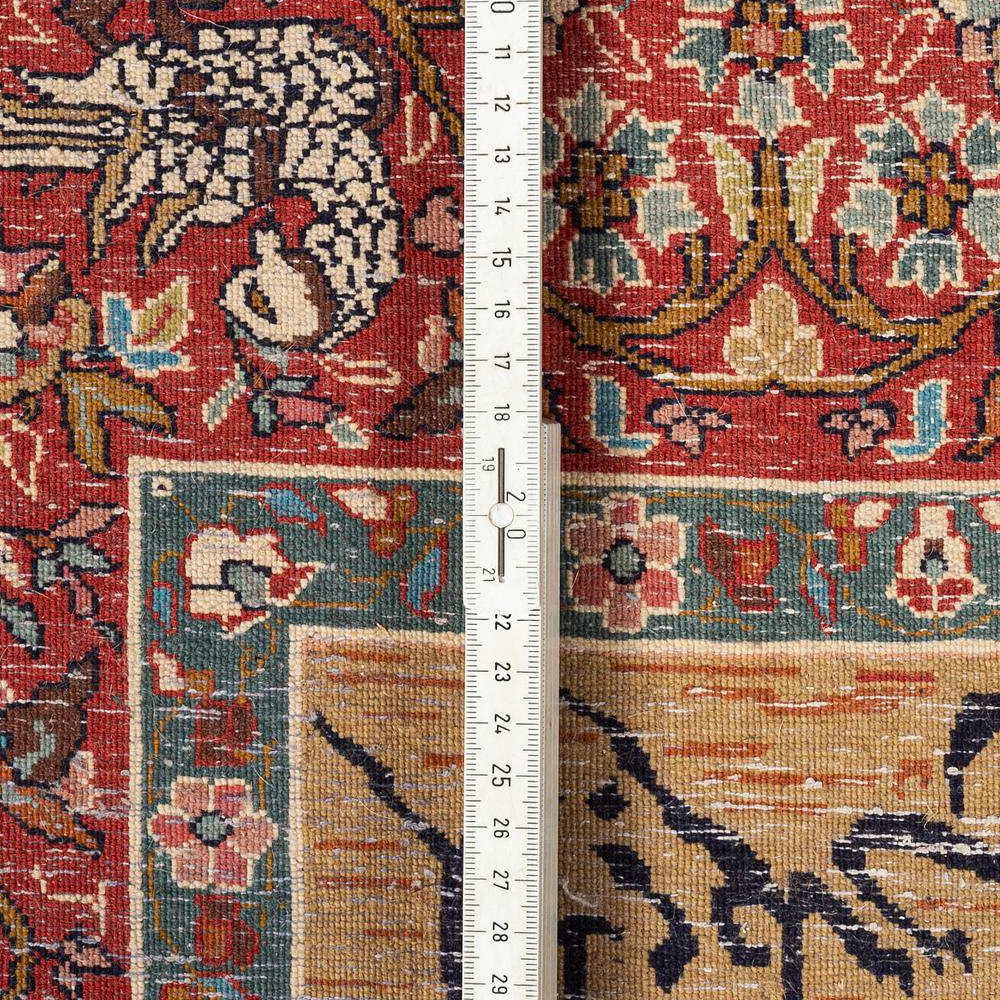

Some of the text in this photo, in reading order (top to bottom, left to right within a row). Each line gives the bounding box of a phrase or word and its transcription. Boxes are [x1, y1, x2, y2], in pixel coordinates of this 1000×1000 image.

[494, 44, 511, 60] 11
[494, 94, 511, 113] 12
[494, 145, 511, 164] 13
[494, 197, 511, 216] 14
[492, 247, 512, 268] 15
[494, 299, 511, 319] 16
[494, 352, 511, 370] 17
[494, 403, 511, 422] 18
[482, 457, 496, 472] 19
[482, 567, 496, 583] 21
[494, 661, 512, 682] 23
[494, 713, 511, 735] 24
[491, 763, 512, 787] 25
[493, 817, 510, 839] 26
[492, 869, 510, 891] 27
[492, 921, 509, 942] 28
[491, 974, 509, 995] 29
